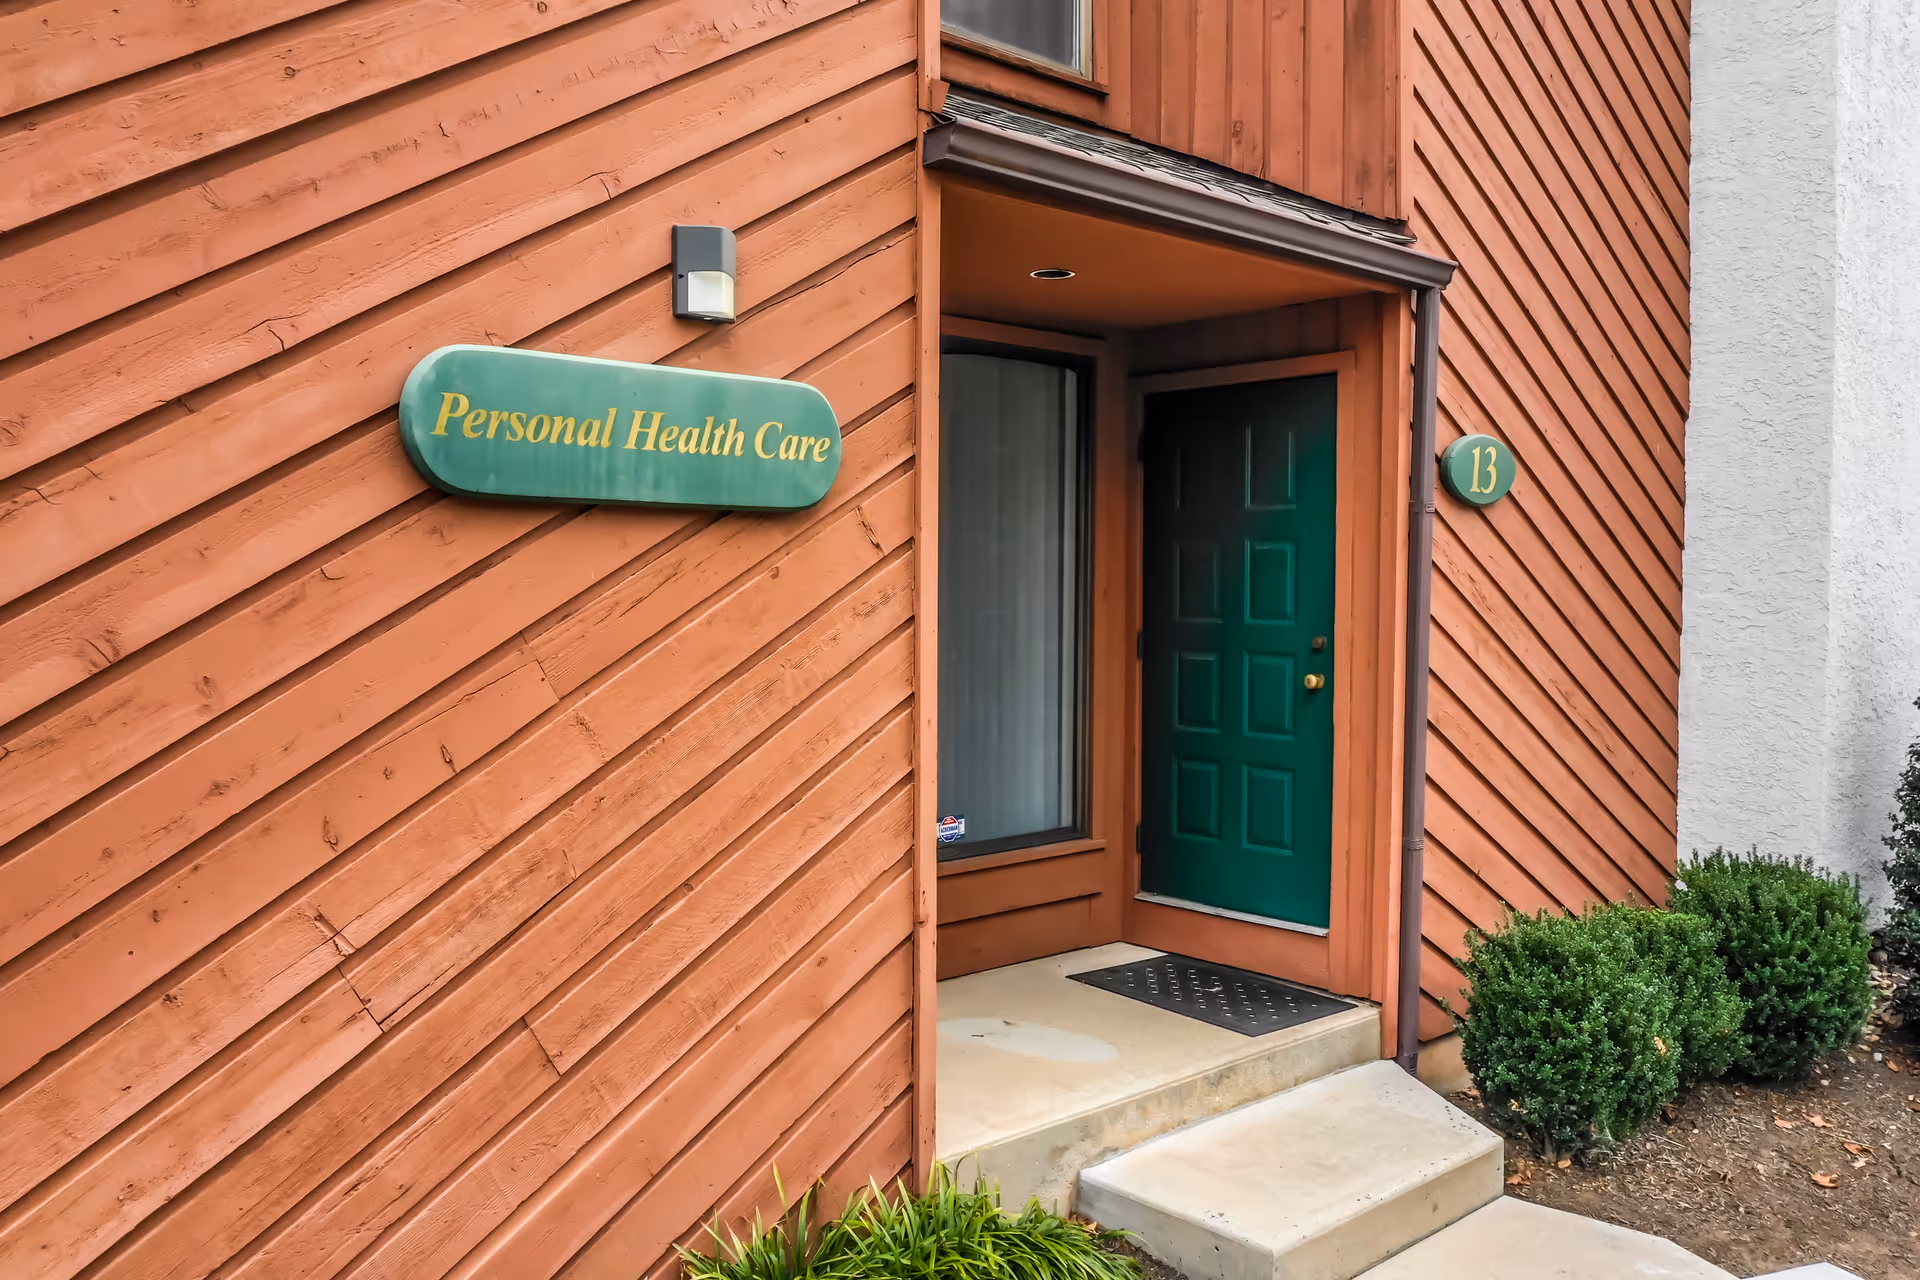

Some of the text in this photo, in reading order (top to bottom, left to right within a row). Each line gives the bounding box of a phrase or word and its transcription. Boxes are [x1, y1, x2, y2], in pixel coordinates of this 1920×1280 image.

[430, 392, 831, 463] Personal Health Care
[1469, 445, 1497, 494] 13
